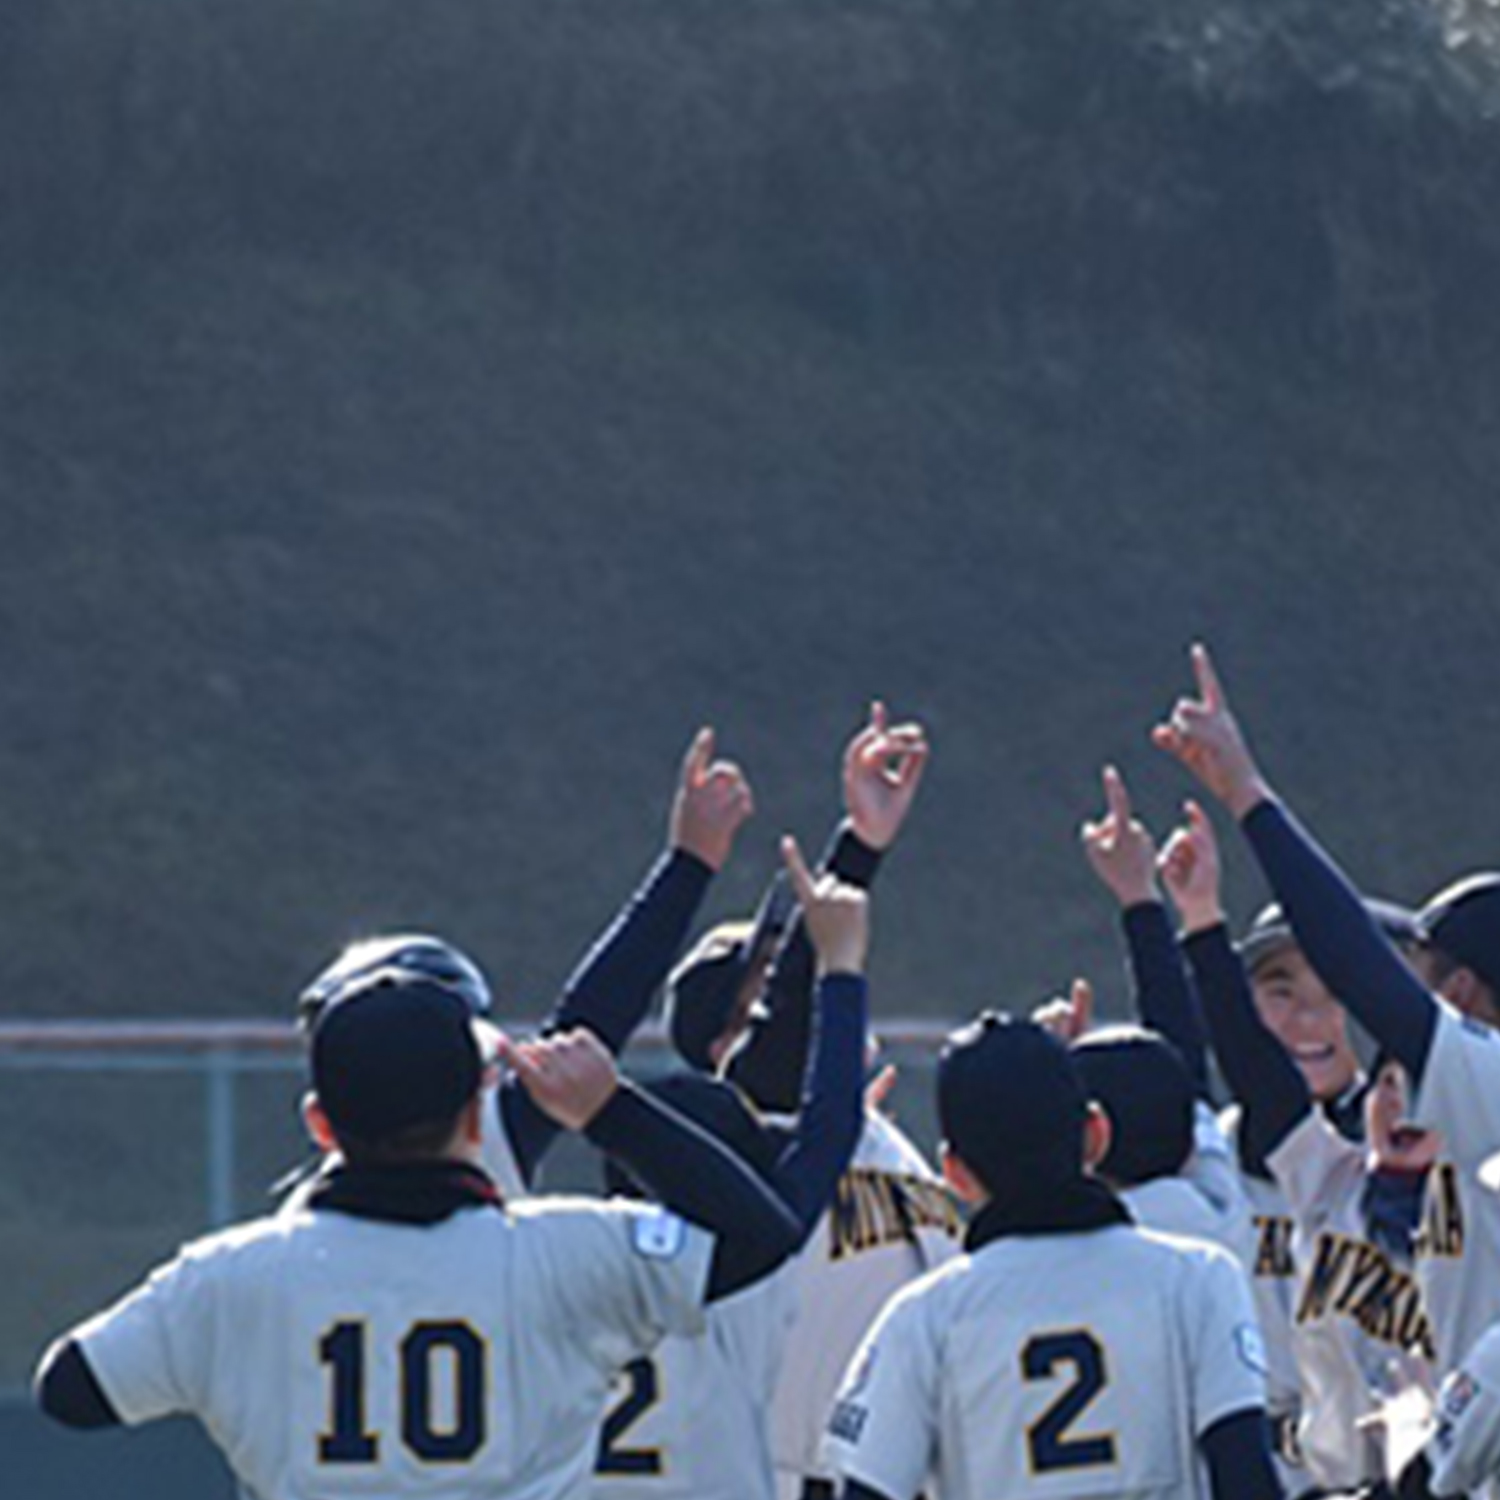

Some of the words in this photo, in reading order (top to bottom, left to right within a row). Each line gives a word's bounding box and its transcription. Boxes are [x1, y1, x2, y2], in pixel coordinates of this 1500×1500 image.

[315, 1317, 490, 1464] 10
[592, 1353, 664, 1476] 2
[1020, 1325, 1118, 1475] 2
